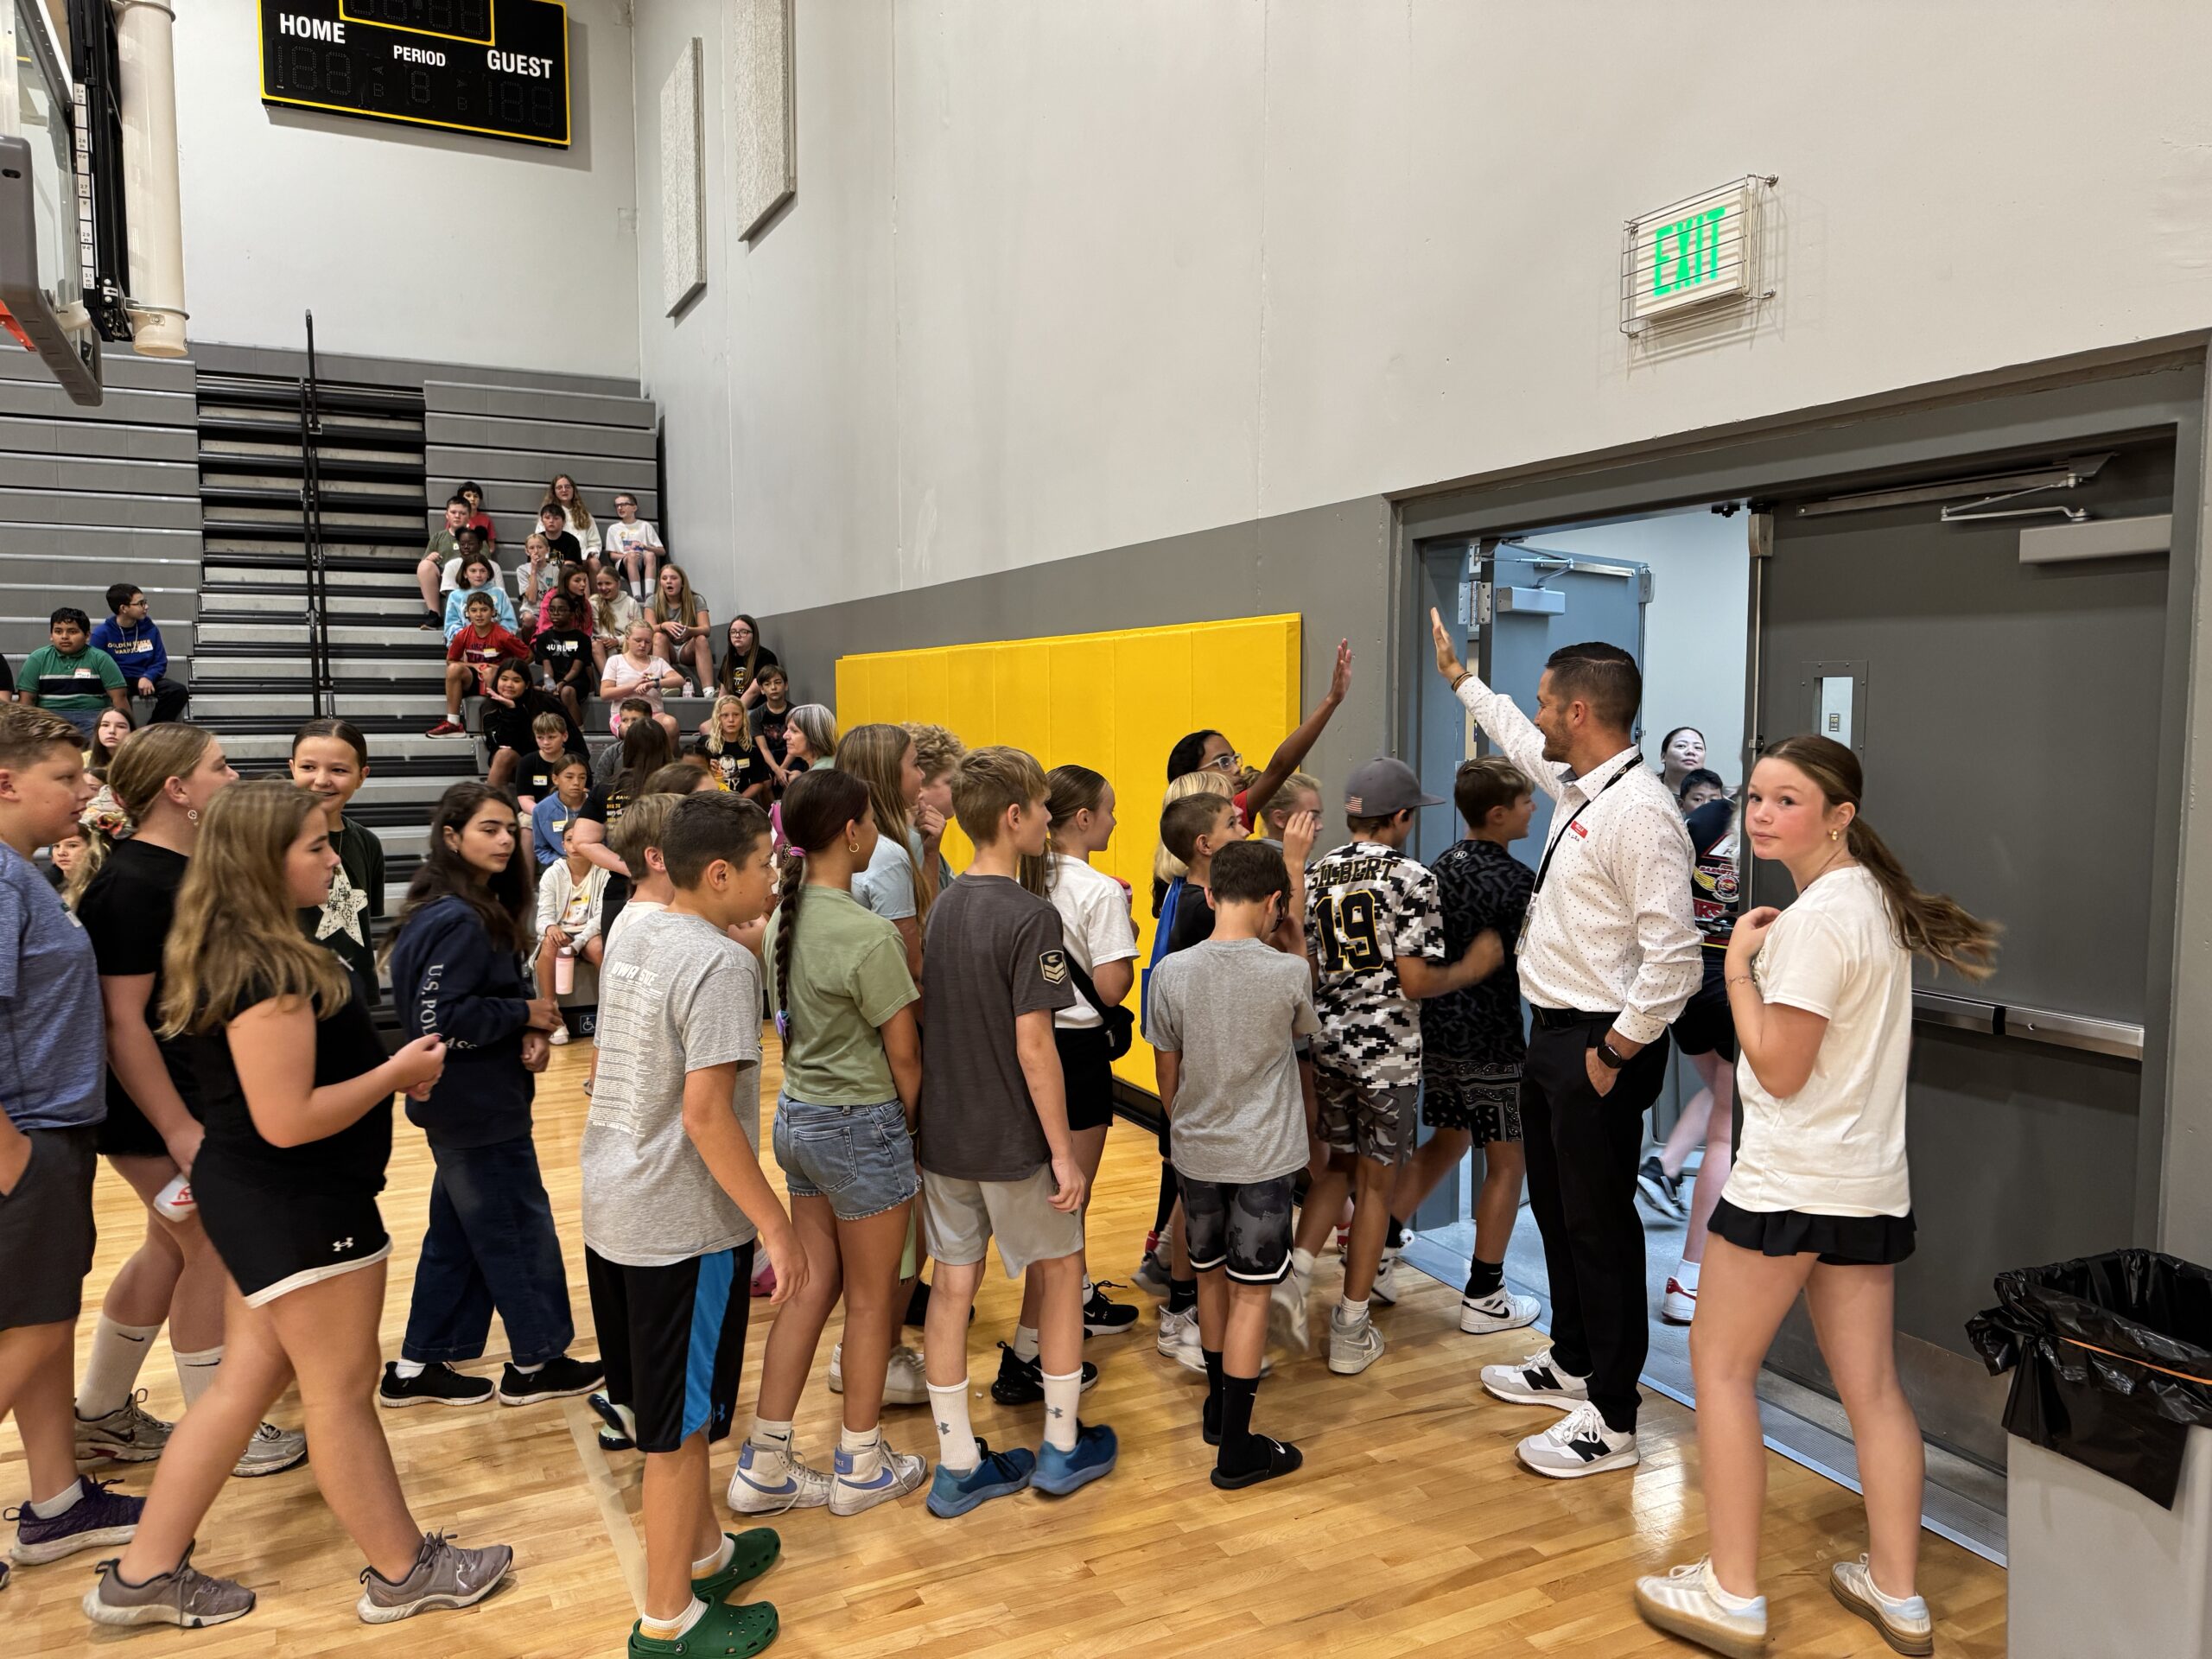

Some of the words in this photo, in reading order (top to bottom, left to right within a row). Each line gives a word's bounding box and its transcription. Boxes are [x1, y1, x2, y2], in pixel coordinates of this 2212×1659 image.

[280, 12, 346, 44] HOME
[393, 45, 446, 67] PERIOD
[486, 50, 554, 79] GUEST
[1653, 207, 1726, 297] EXIT
[1307, 858, 1399, 891] GILBERT
[1314, 889, 1385, 973] 19
[421, 963, 444, 995] U.S.
[420, 999, 437, 1035] POL
[1522, 1367, 1564, 1390] N
[1567, 1431, 1611, 1463] N
